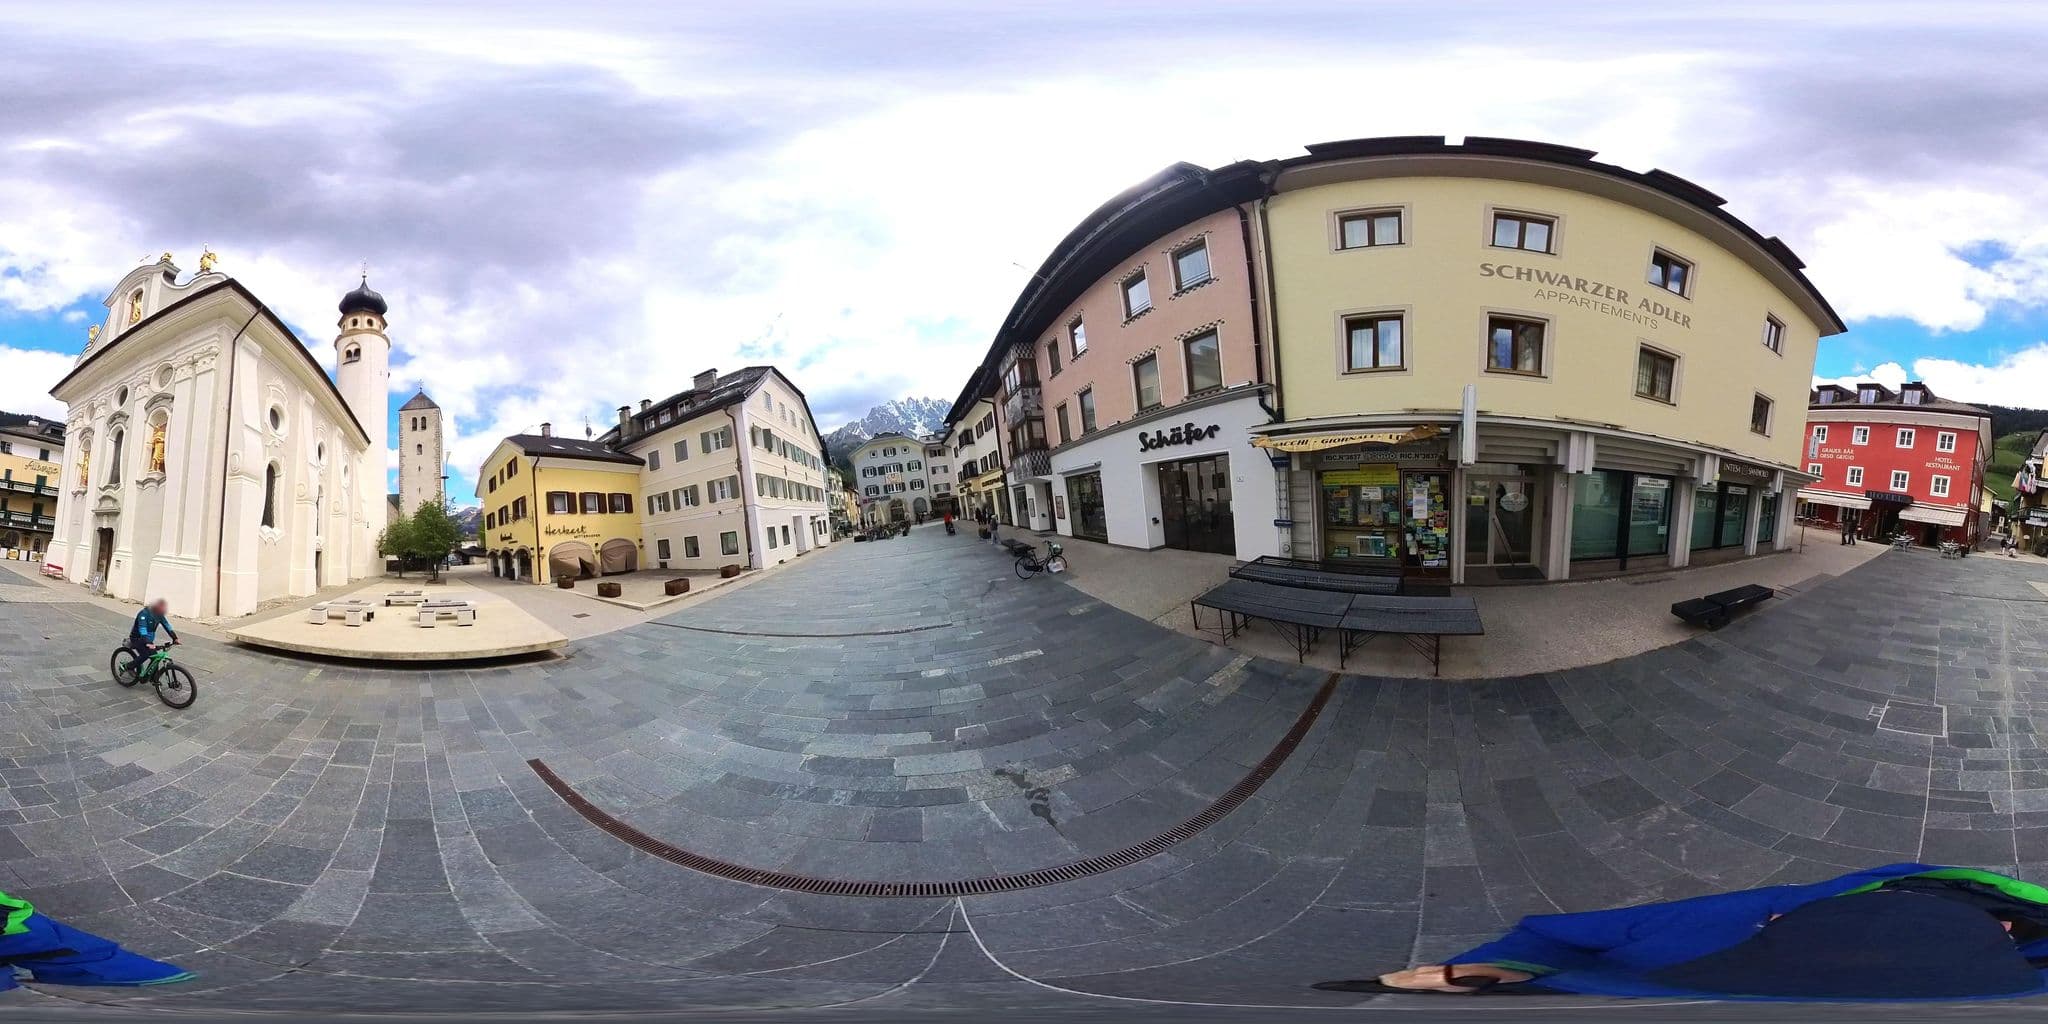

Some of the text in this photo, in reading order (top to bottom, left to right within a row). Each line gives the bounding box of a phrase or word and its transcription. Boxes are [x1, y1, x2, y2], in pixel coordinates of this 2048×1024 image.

[1479, 262, 1692, 330] SCHWARZER ADLER
[1534, 288, 1658, 330] APPARTEMENTS
[1139, 422, 1221, 453] Schäfer
[1925, 462, 1960, 471] RESTAURANT
[1935, 456, 1952, 464] HOTEL
[544, 523, 587, 536] Herbert
